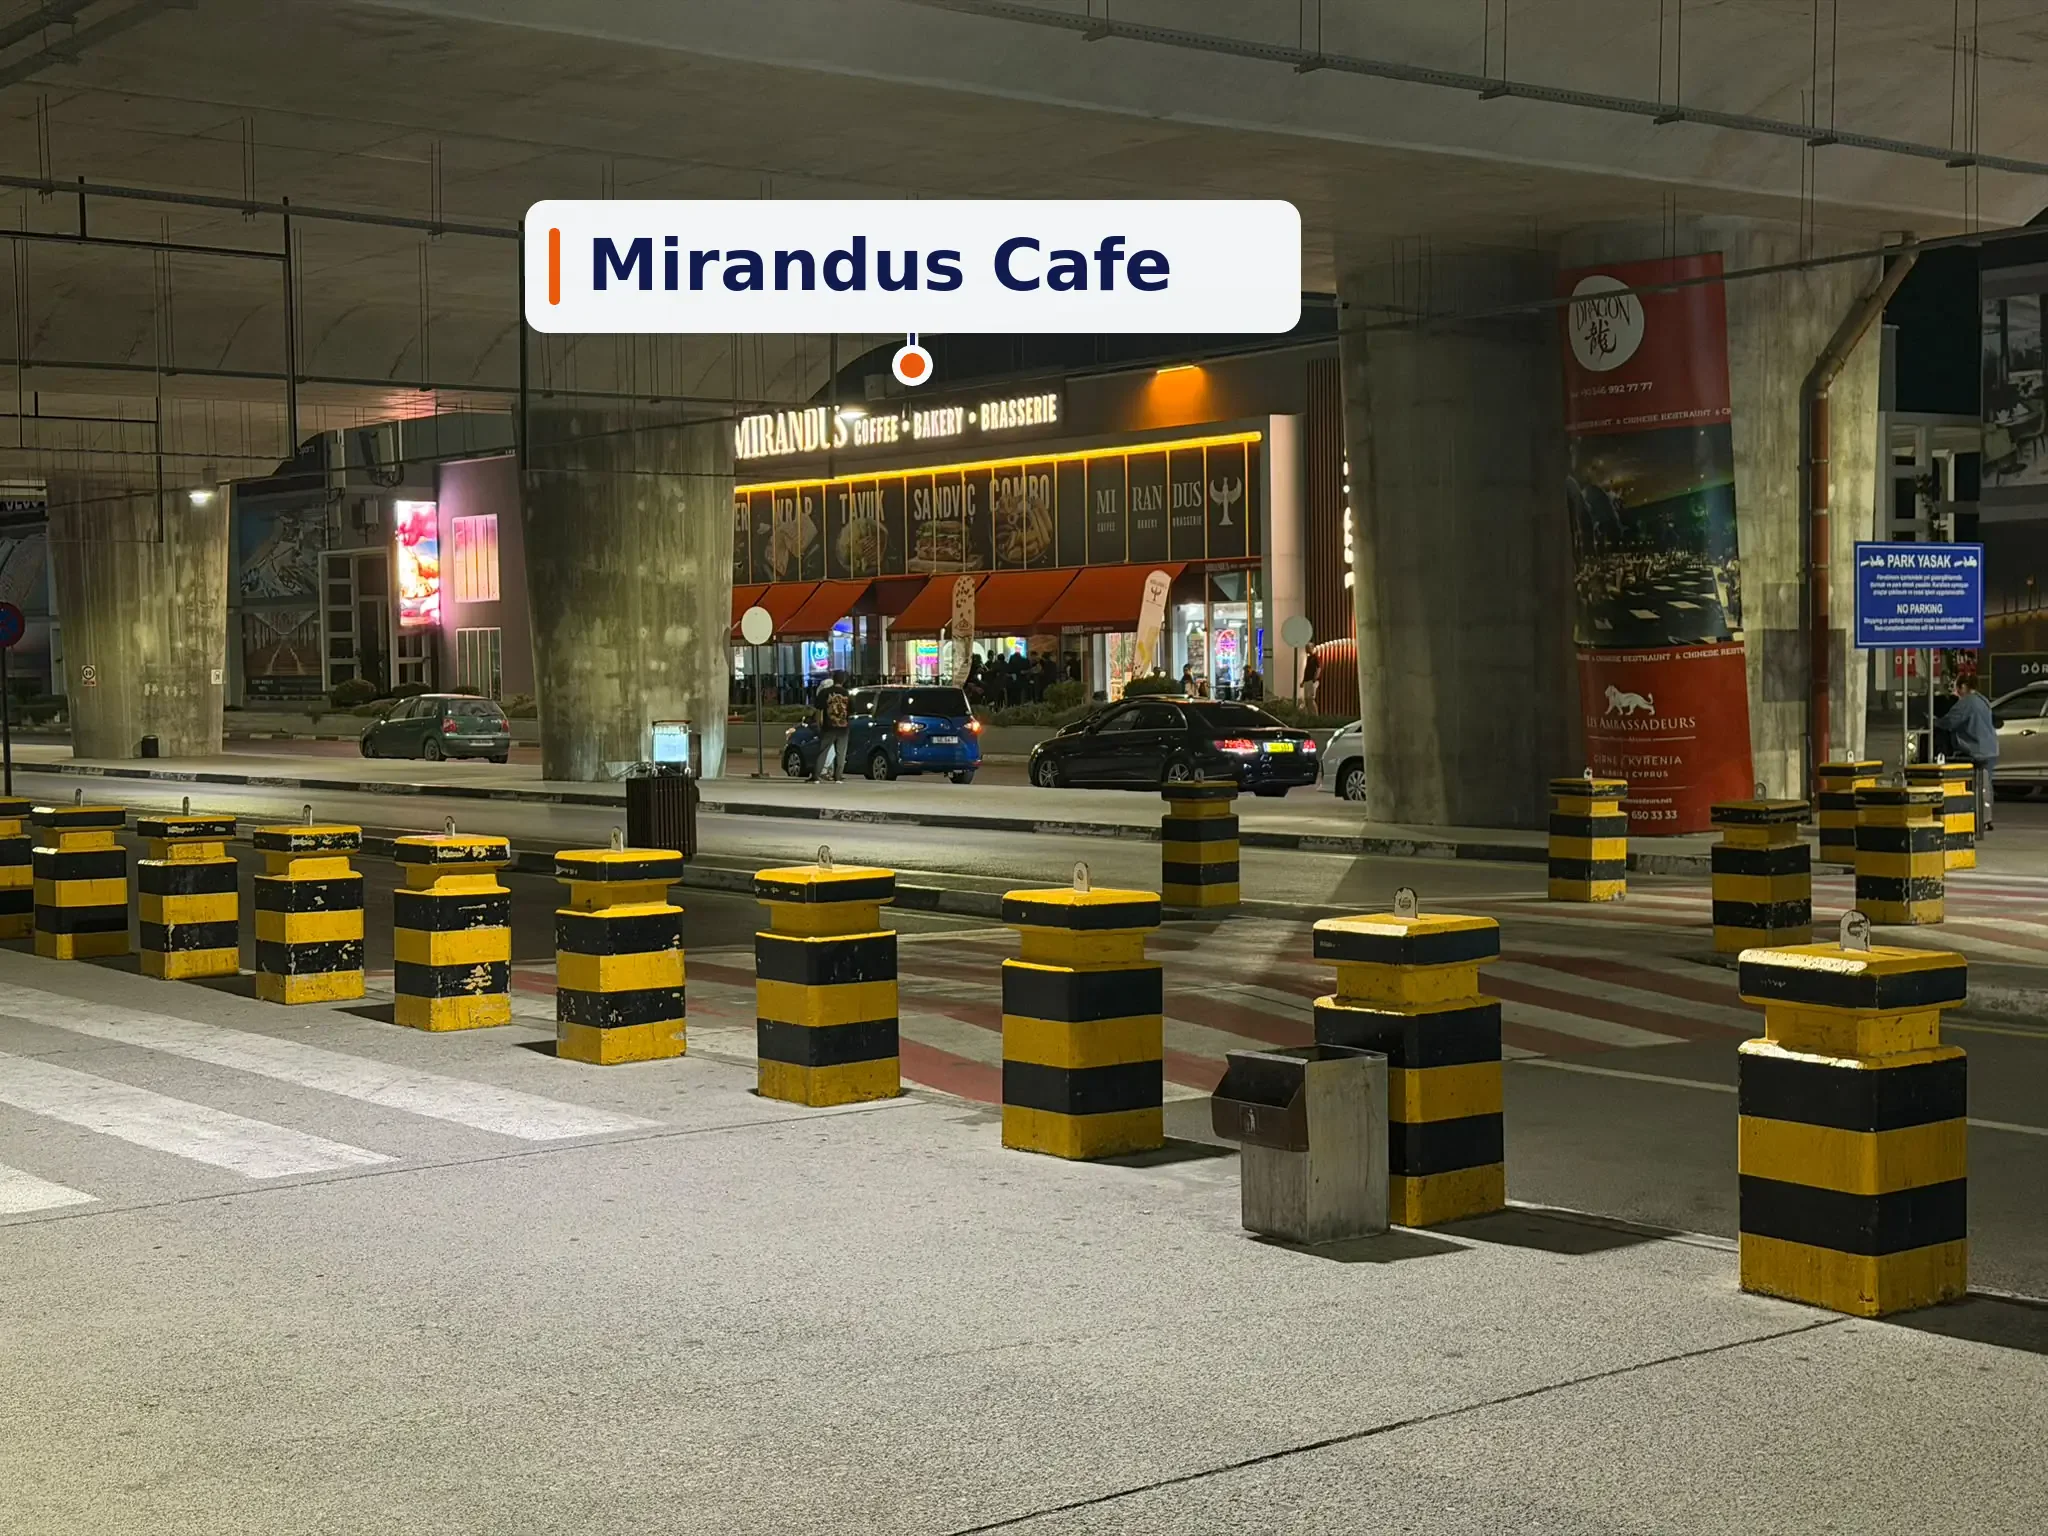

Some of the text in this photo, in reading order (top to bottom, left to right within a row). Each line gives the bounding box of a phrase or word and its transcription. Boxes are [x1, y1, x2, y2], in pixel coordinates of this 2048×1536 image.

[1607, 384, 1625, 394] 992
[1626, 383, 1638, 393] 77
[1640, 382, 1653, 392] 77
[736, 392, 1057, 460] MIRANDUS COFFEE BAKERY BRASSERIE
[1096, 480, 1202, 515] MI RAN DUS
[1887, 554, 1951, 569] PARK YASAK
[1897, 603, 1943, 614] NO PARKING
[1599, 716, 1696, 731] AMBASSADEURS
[1628, 754, 1682, 767] KYRENIA
[1631, 770, 1669, 779] CYPRUS
[1631, 809, 1677, 820] 650 33 33
